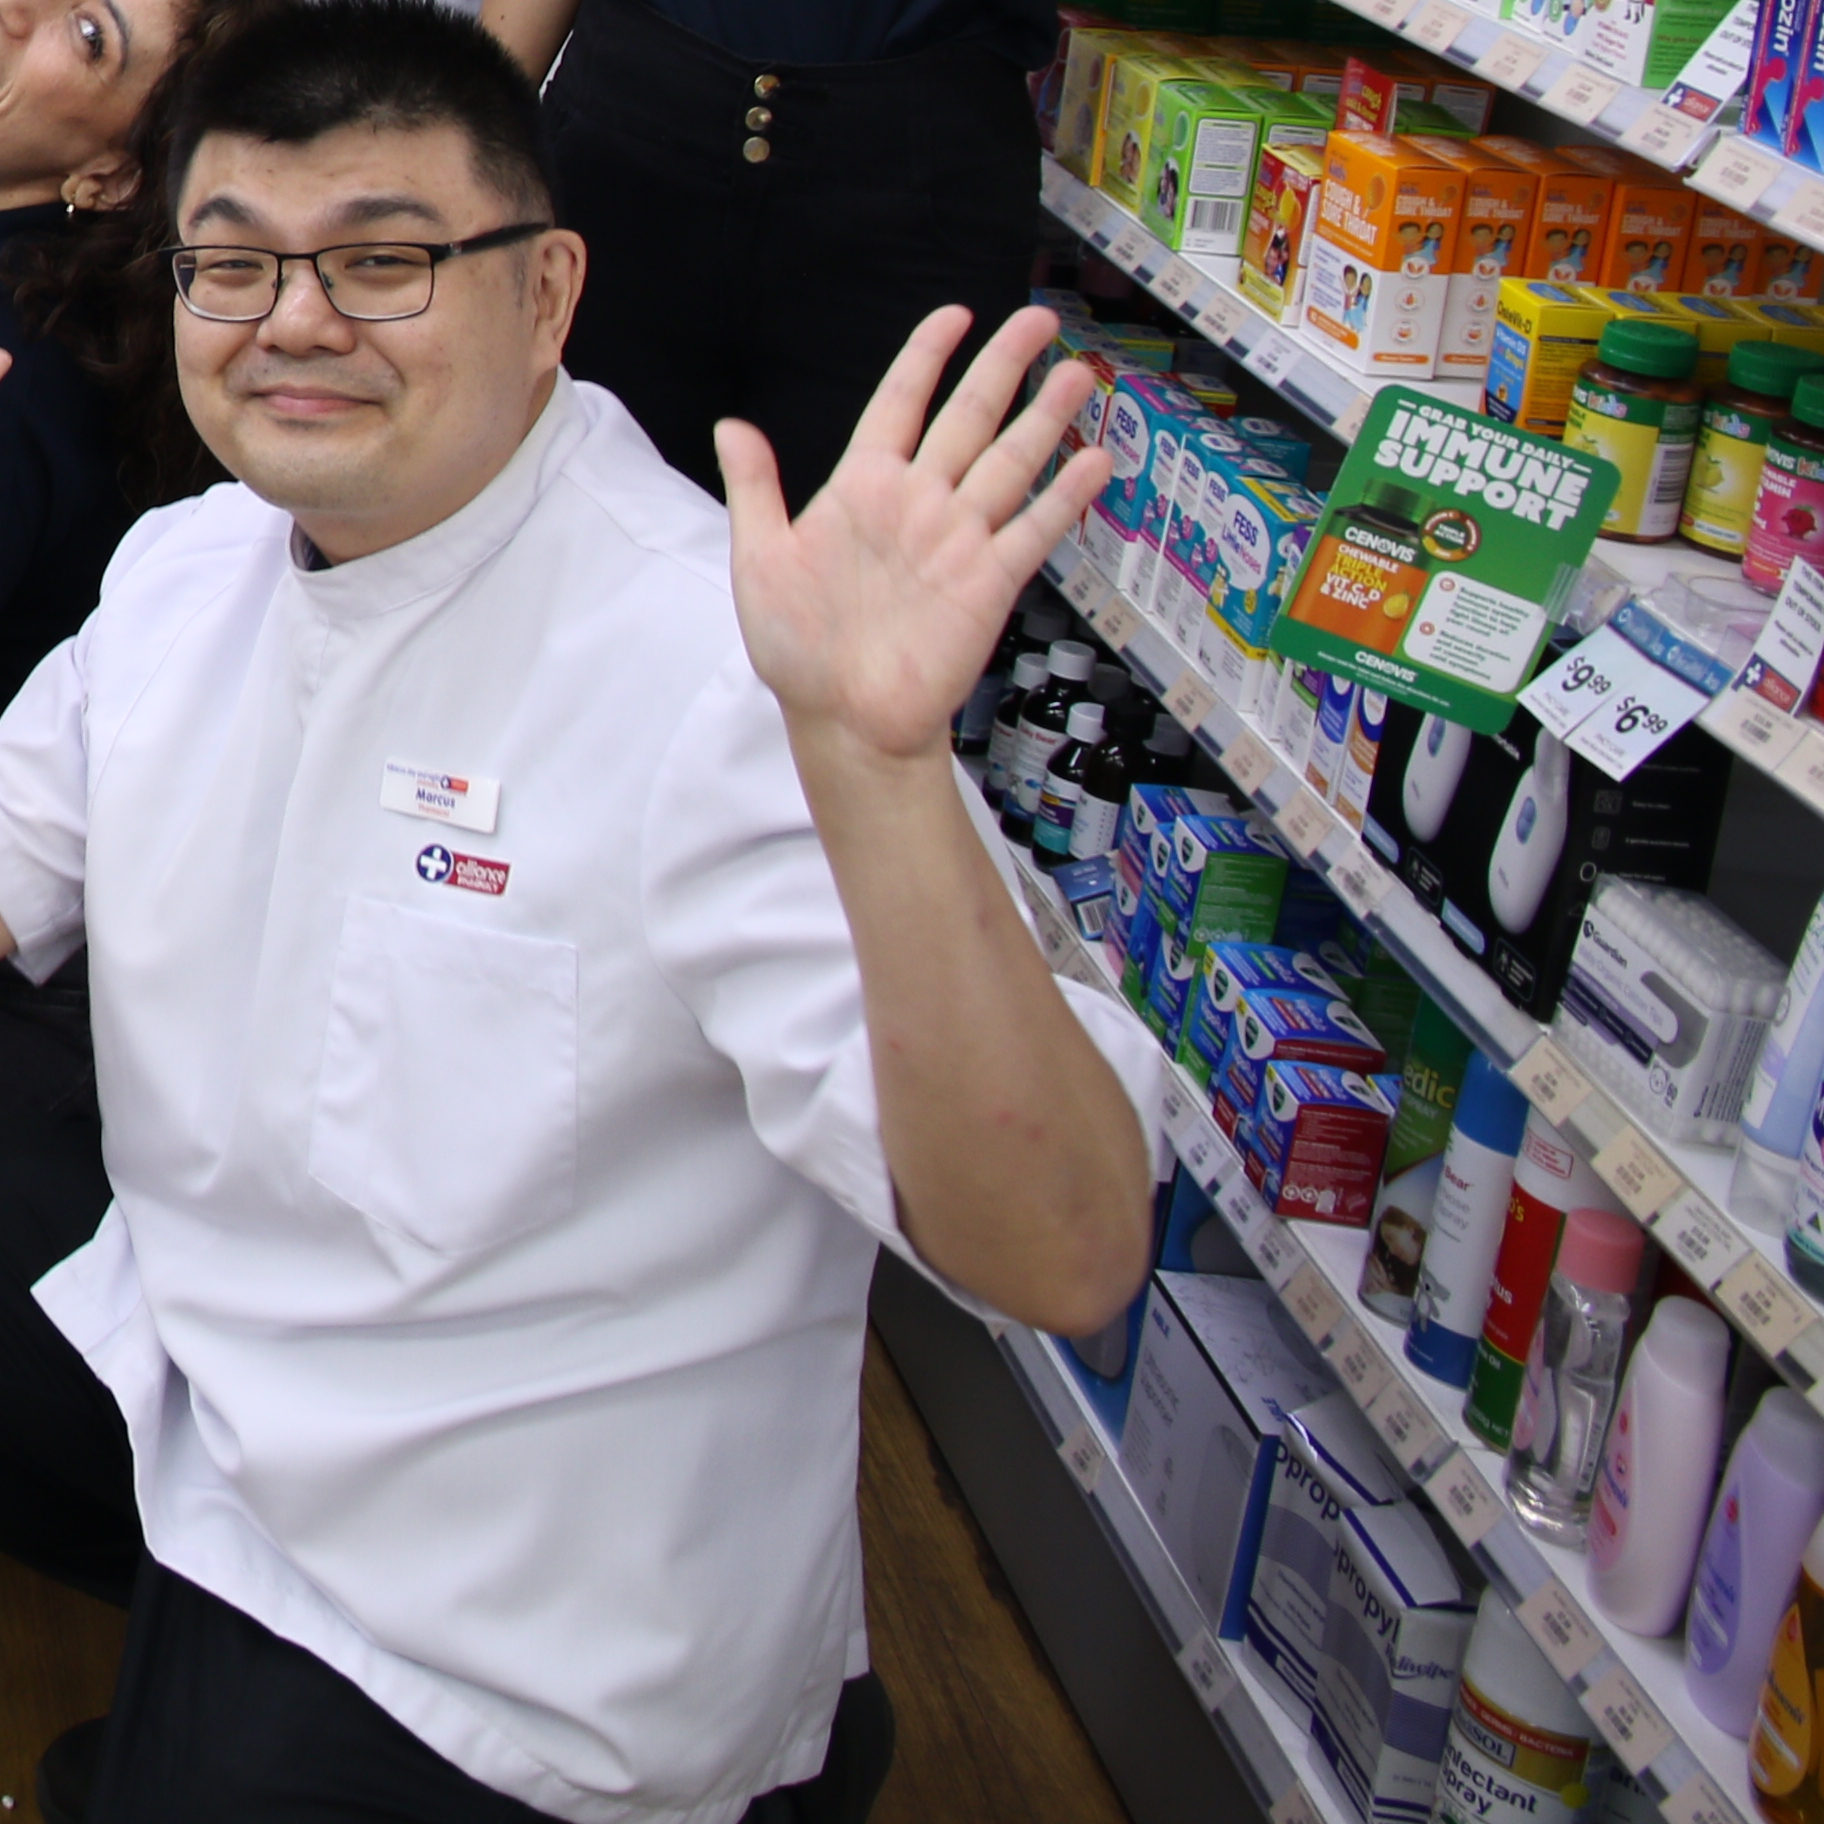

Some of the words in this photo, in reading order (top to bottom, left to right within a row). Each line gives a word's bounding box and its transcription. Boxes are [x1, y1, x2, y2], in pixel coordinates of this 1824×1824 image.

[1323, 178, 1353, 209] COUGH
[1396, 195, 1427, 208] COUGH
[1468, 196, 1500, 210] COUGH
[1394, 205, 1418, 217] SORE
[1420, 205, 1453, 218] THROAT
[1467, 206, 1490, 219] SORE
[1491, 207, 1525, 220] THROAT
[1541, 211, 1565, 224] SORE
[1567, 212, 1600, 225] THROAT
[1542, 201, 1575, 215] COUGH
[1623, 214, 1656, 228] COUGH
[1320, 203, 1343, 229] SORE
[1341, 214, 1379, 246] THROAT
[1621, 224, 1645, 237] SORE
[1648, 224, 1682, 238] THROAT
[1497, 298, 1532, 335] OsteVit-D
[1586, 389, 1630, 420] Kids
[1115, 405, 1139, 440] FESS
[1712, 410, 1752, 439] Kids
[1159, 435, 1176, 462] FESS
[1418, 404, 1468, 432] GRAB
[1470, 421, 1521, 450] YOUR
[1520, 442, 1575, 470] DAILY
[1183, 456, 1200, 482] FESS
[1385, 408, 1590, 507] IMMUNE
[1208, 477, 1227, 504] FESS
[1372, 437, 1578, 532] SUPPORT
[1233, 509, 1259, 548] FESS
[1434, 529, 1465, 545] ACTION
[1437, 522, 1467, 538] TRIPLE
[1343, 525, 1417, 564] CENOVIS
[1334, 552, 1384, 579] TRIPLE
[1337, 543, 1401, 575] CHEWABLE
[1325, 572, 1351, 589] VIT
[1367, 587, 1382, 603] D
[1329, 563, 1389, 592] ACTION
[1331, 587, 1371, 610] ZINC
[1452, 601, 1486, 621] function
[1456, 593, 1491, 612] immune
[1490, 604, 1522, 625] system
[1460, 585, 1498, 606] Supports
[1497, 598, 1531, 620] healthy
[1785, 596, 1798, 613] OUT
[1464, 622, 1492, 638] round
[1435, 637, 1454, 649] and
[1453, 642, 1488, 664] severity
[1439, 629, 1476, 651] Reduces
[1474, 641, 1512, 663] duration
[1442, 648, 1480, 667] common
[1355, 649, 1419, 684] CENOVIS
[1447, 658, 1492, 681] symptoms
[416, 786, 456, 809] Marcus
[455, 858, 506, 886] alliance
[1593, 930, 1627, 969] Guardian
[1518, 1732, 1575, 1758] BACTERIA
